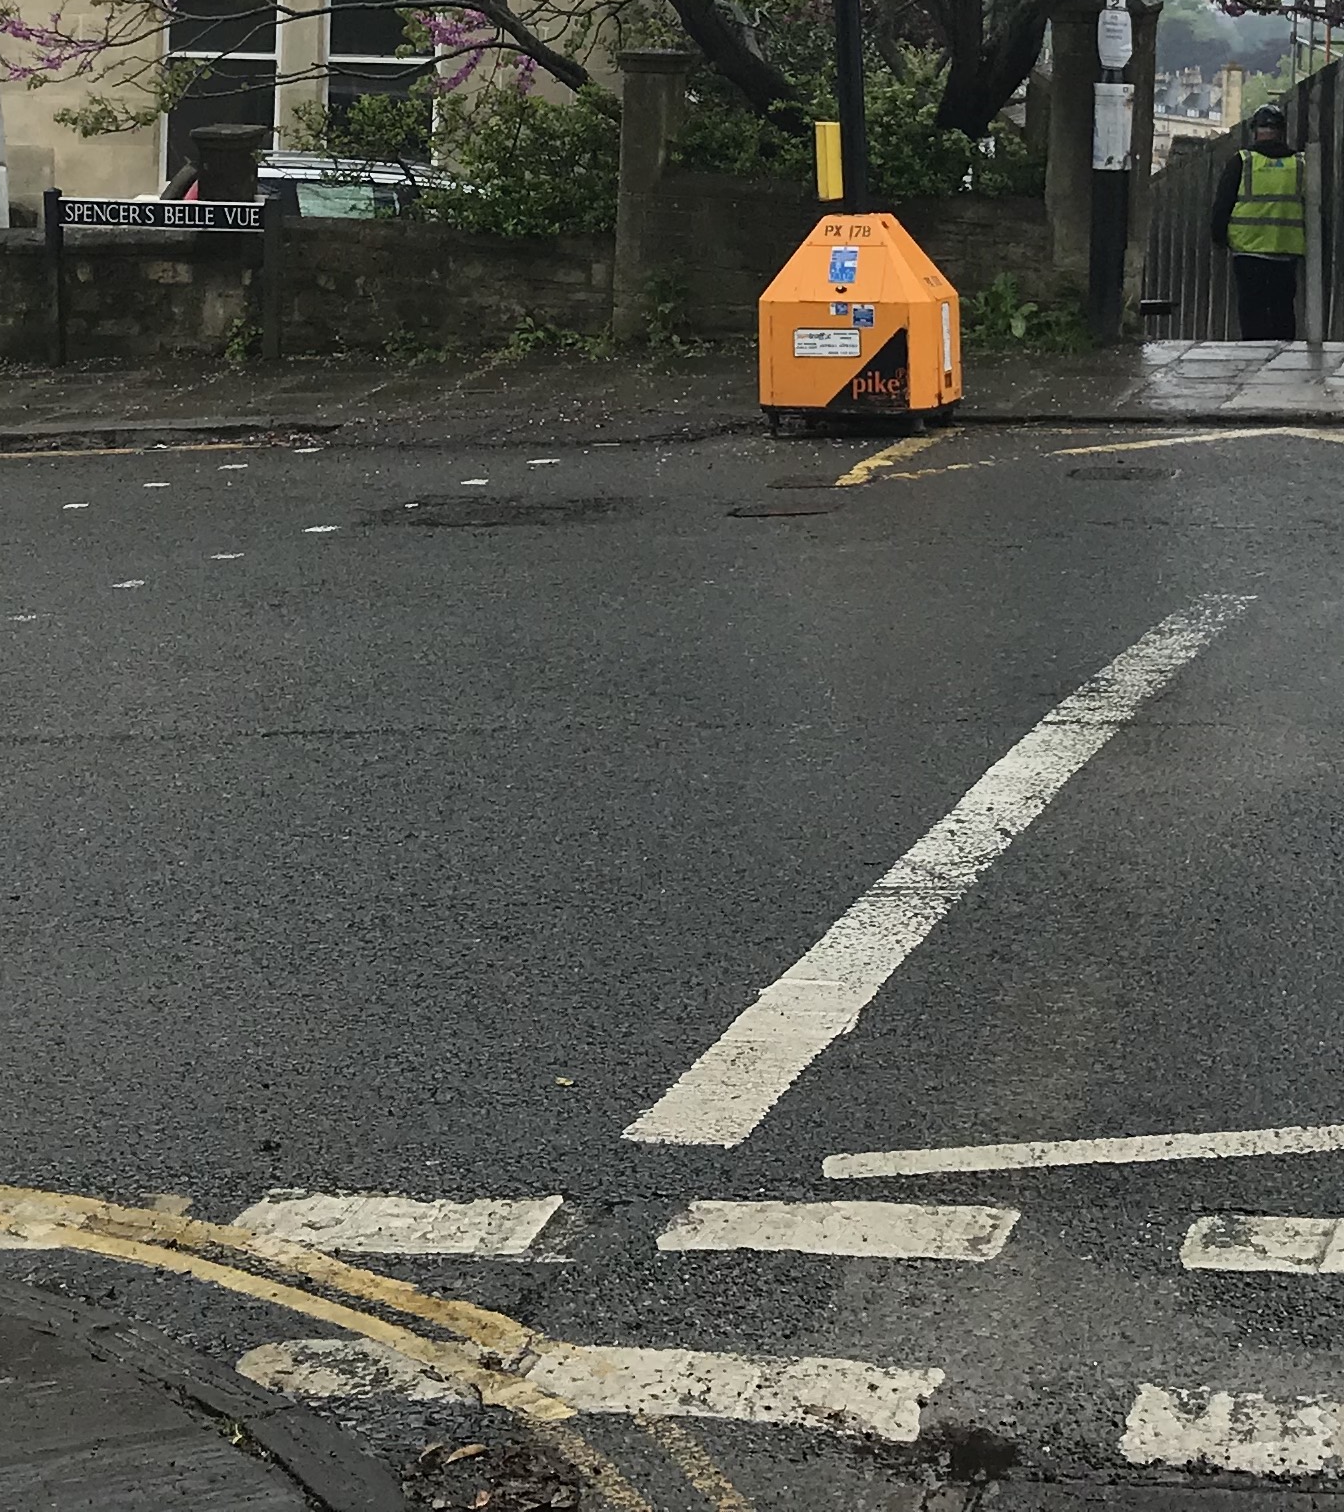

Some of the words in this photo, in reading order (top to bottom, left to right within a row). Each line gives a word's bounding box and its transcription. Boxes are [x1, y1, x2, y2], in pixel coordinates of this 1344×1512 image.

[65, 203, 155, 224] SPENCER'S
[164, 206, 215, 225] BELLE
[224, 207, 260, 226] VUE
[824, 225, 842, 236] PX
[852, 371, 901, 400] pike
